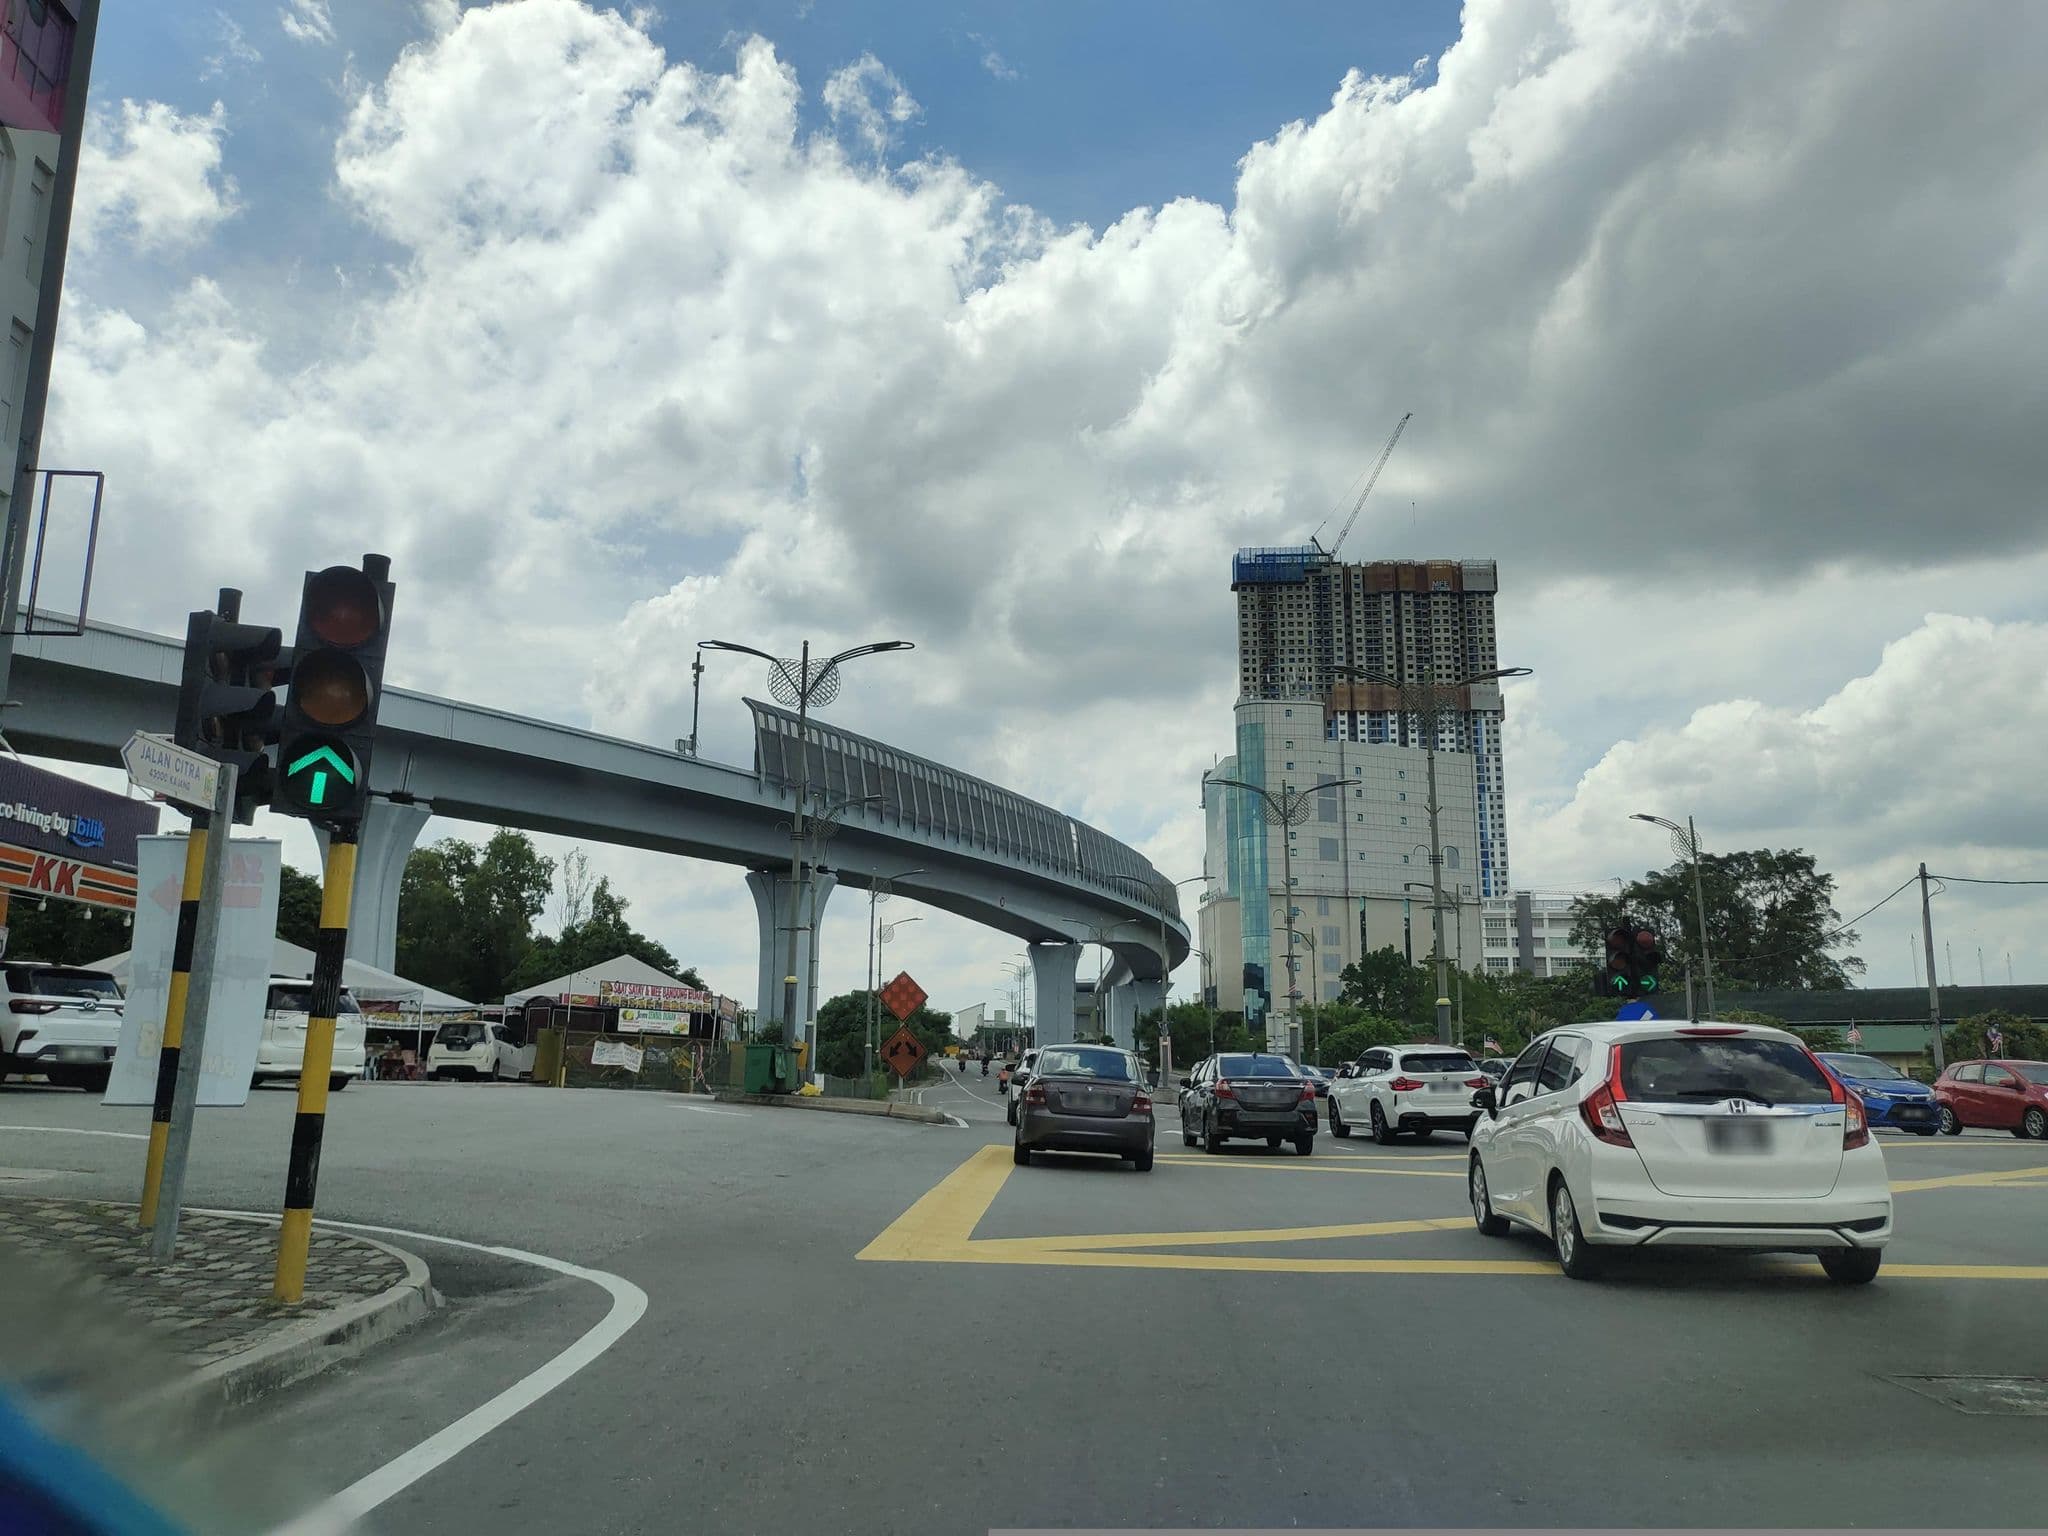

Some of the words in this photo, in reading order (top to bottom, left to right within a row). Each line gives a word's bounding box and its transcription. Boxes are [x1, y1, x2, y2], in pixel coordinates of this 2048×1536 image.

[140, 744, 171, 769] JALAN
[174, 758, 200, 780] CITRA
[51, 811, 70, 837] by
[28, 855, 82, 896] KK
